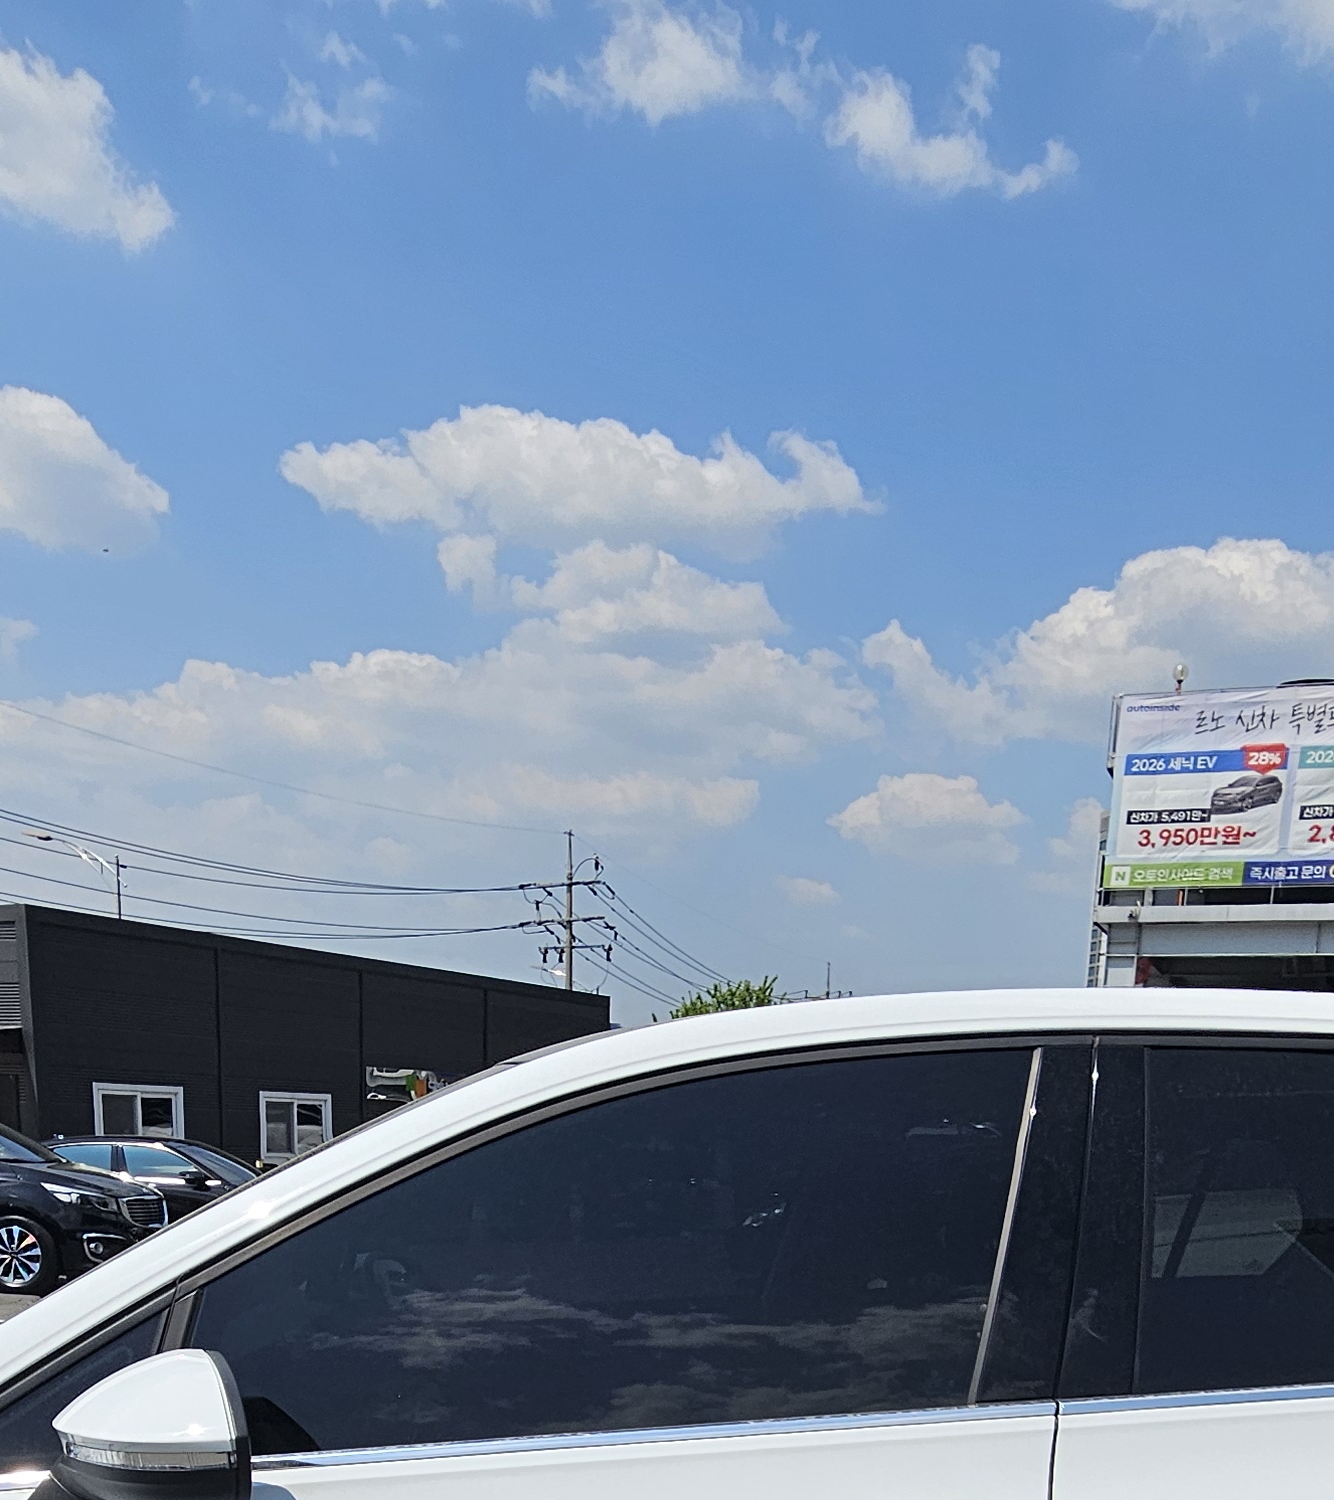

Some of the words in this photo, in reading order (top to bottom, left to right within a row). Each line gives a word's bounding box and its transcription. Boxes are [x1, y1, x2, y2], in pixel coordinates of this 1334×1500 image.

[1194, 709, 1226, 735] 르노
[1235, 705, 1280, 733] 신차
[1130, 758, 1166, 772] 2026
[1167, 756, 1194, 771] 세닉
[1196, 756, 1218, 770] EV
[1247, 751, 1282, 766] 28%
[1208, 867, 1234, 881] 검색
[1249, 866, 1299, 880] 즉시출고
[1300, 866, 1327, 880] 문의
